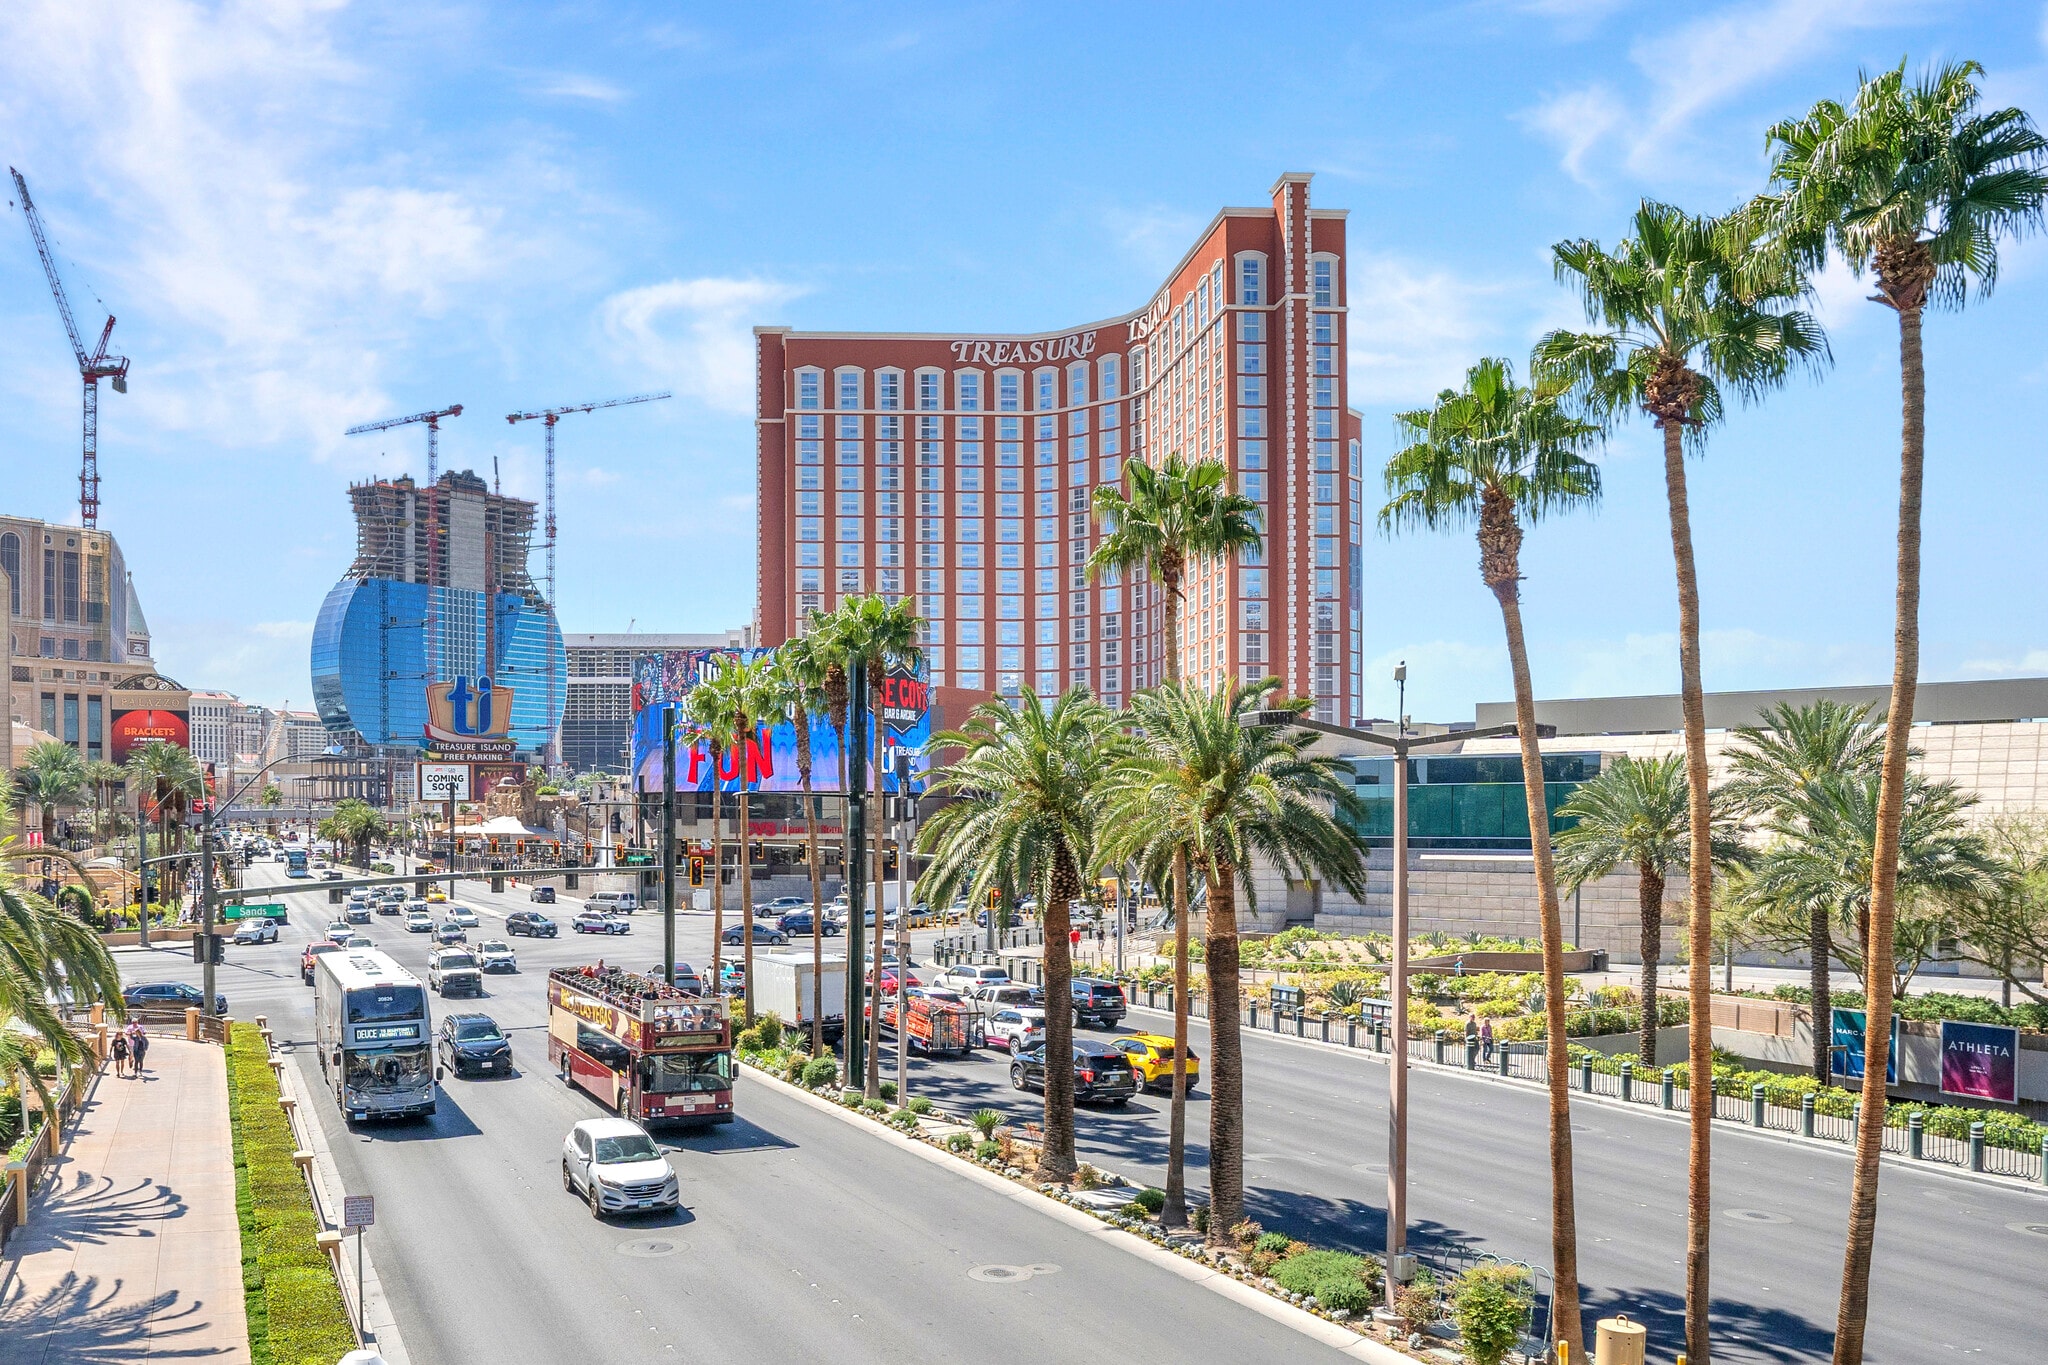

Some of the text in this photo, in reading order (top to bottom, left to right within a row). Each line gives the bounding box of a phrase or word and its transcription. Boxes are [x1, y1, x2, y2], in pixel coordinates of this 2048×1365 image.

[951, 289, 1171, 367] TREASURE ISLAND
[121, 698, 180, 707] PALAZZO
[884, 708, 896, 719] BAR
[124, 727, 176, 736] BRACKETS
[435, 743, 511, 751] TREASURE ISLAND
[426, 774, 464, 783] COMING
[432, 783, 459, 791] SOON
[240, 907, 267, 916] Sands
[592, 1005, 613, 1030] VEGAS
[356, 1029, 378, 1039] DEUCE
[1836, 1028, 1858, 1036] MARC
[1949, 1040, 2010, 1058] ATHLETA
